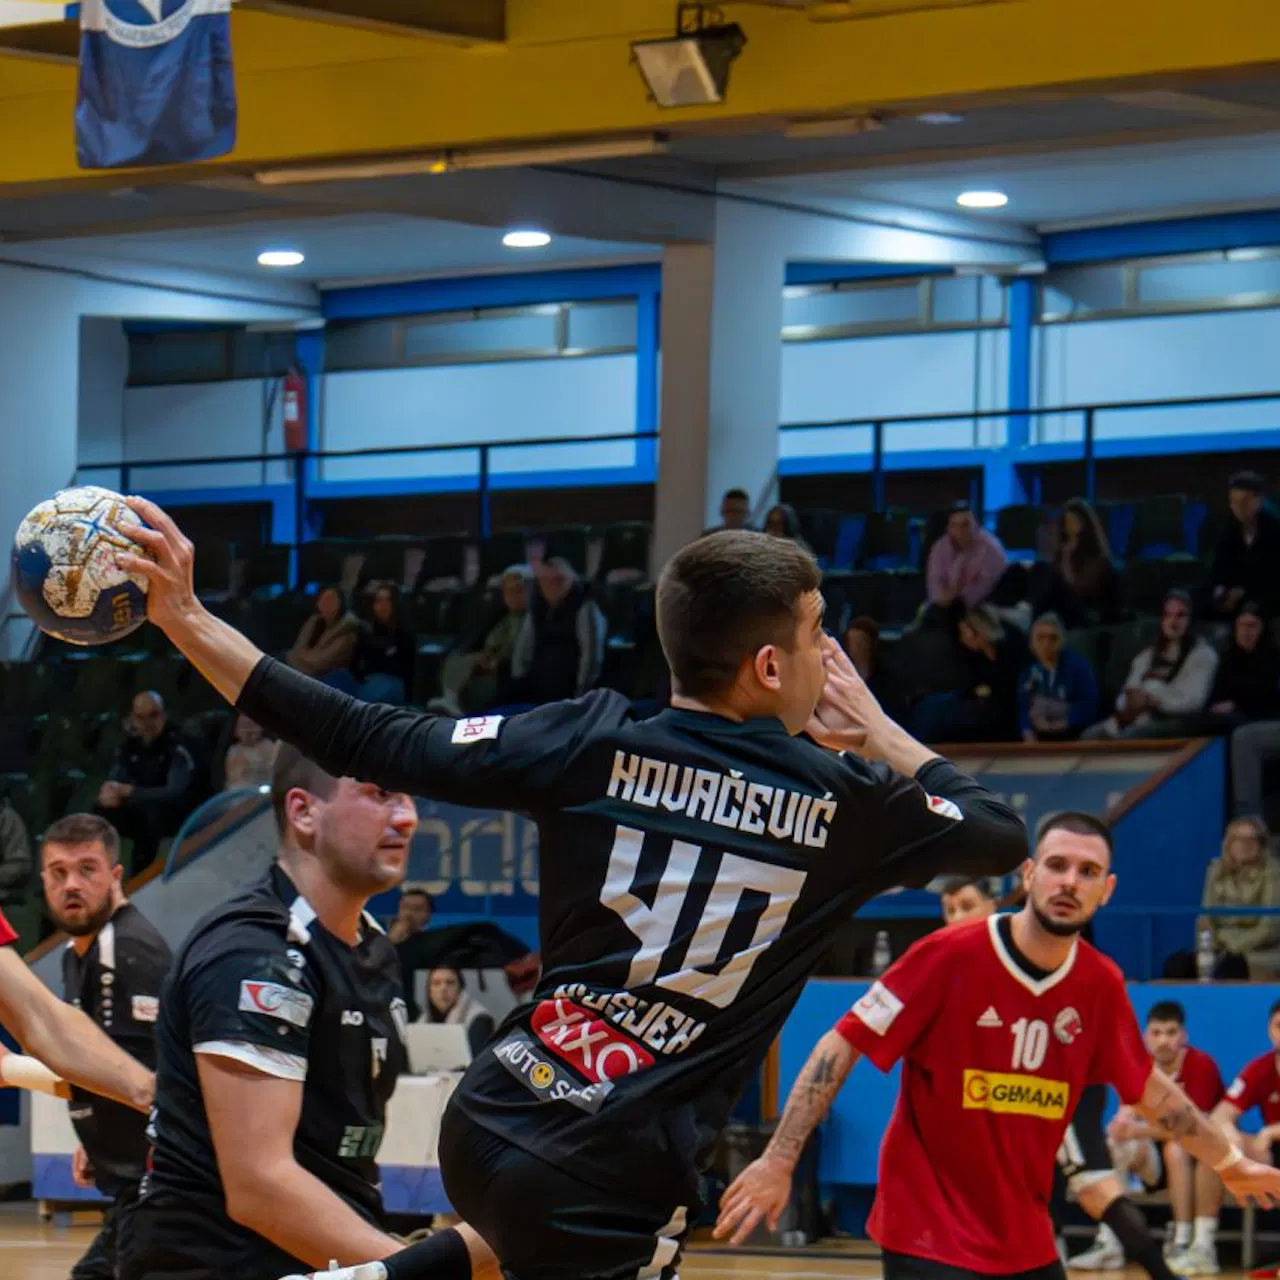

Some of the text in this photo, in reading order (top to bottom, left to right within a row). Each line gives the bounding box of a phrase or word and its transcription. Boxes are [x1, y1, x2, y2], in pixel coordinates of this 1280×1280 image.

[606, 749, 838, 850] KOVAČEVIĆ
[599, 825, 809, 1009] 40
[1010, 1017, 1049, 1070] 10
